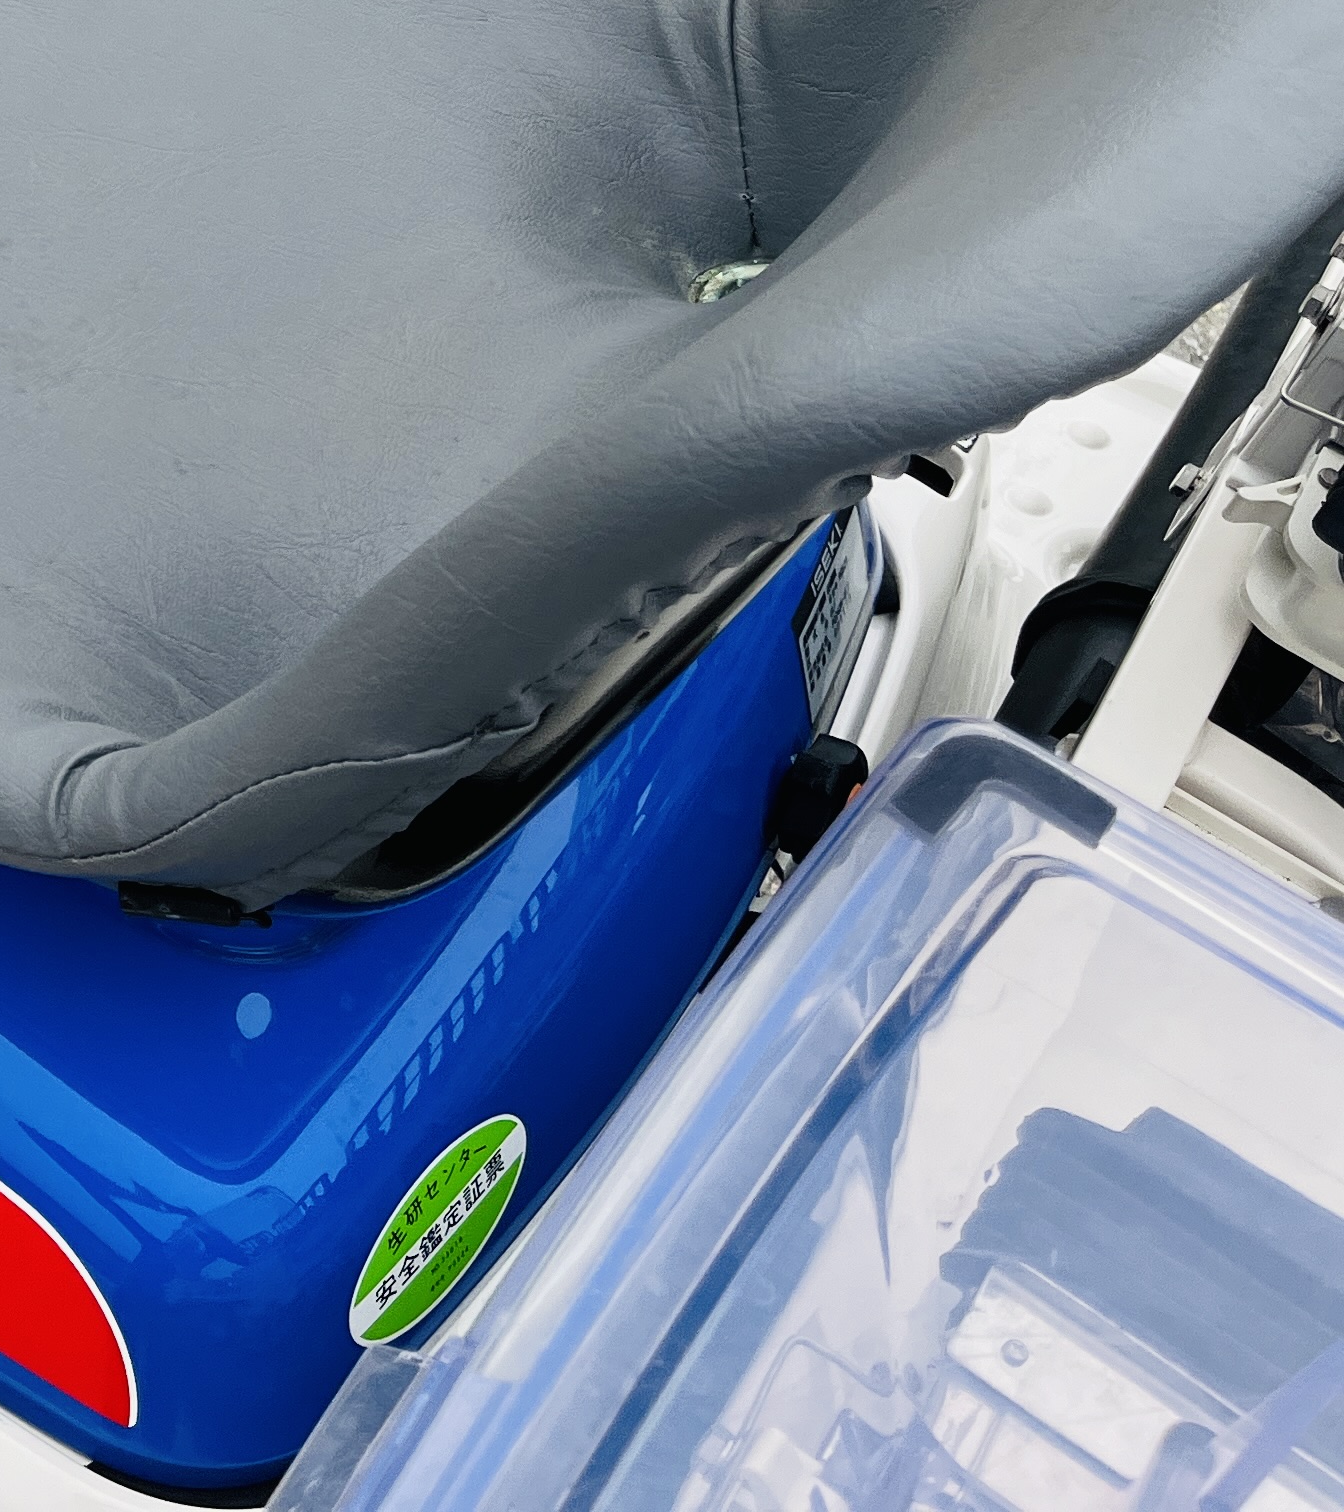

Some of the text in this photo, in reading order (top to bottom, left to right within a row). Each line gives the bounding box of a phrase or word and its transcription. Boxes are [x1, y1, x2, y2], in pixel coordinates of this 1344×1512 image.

[810, 522, 844, 598] ISEKI
[374, 1148, 505, 1311] 安全鑑定証票
[387, 1144, 488, 1256] 生研センター
